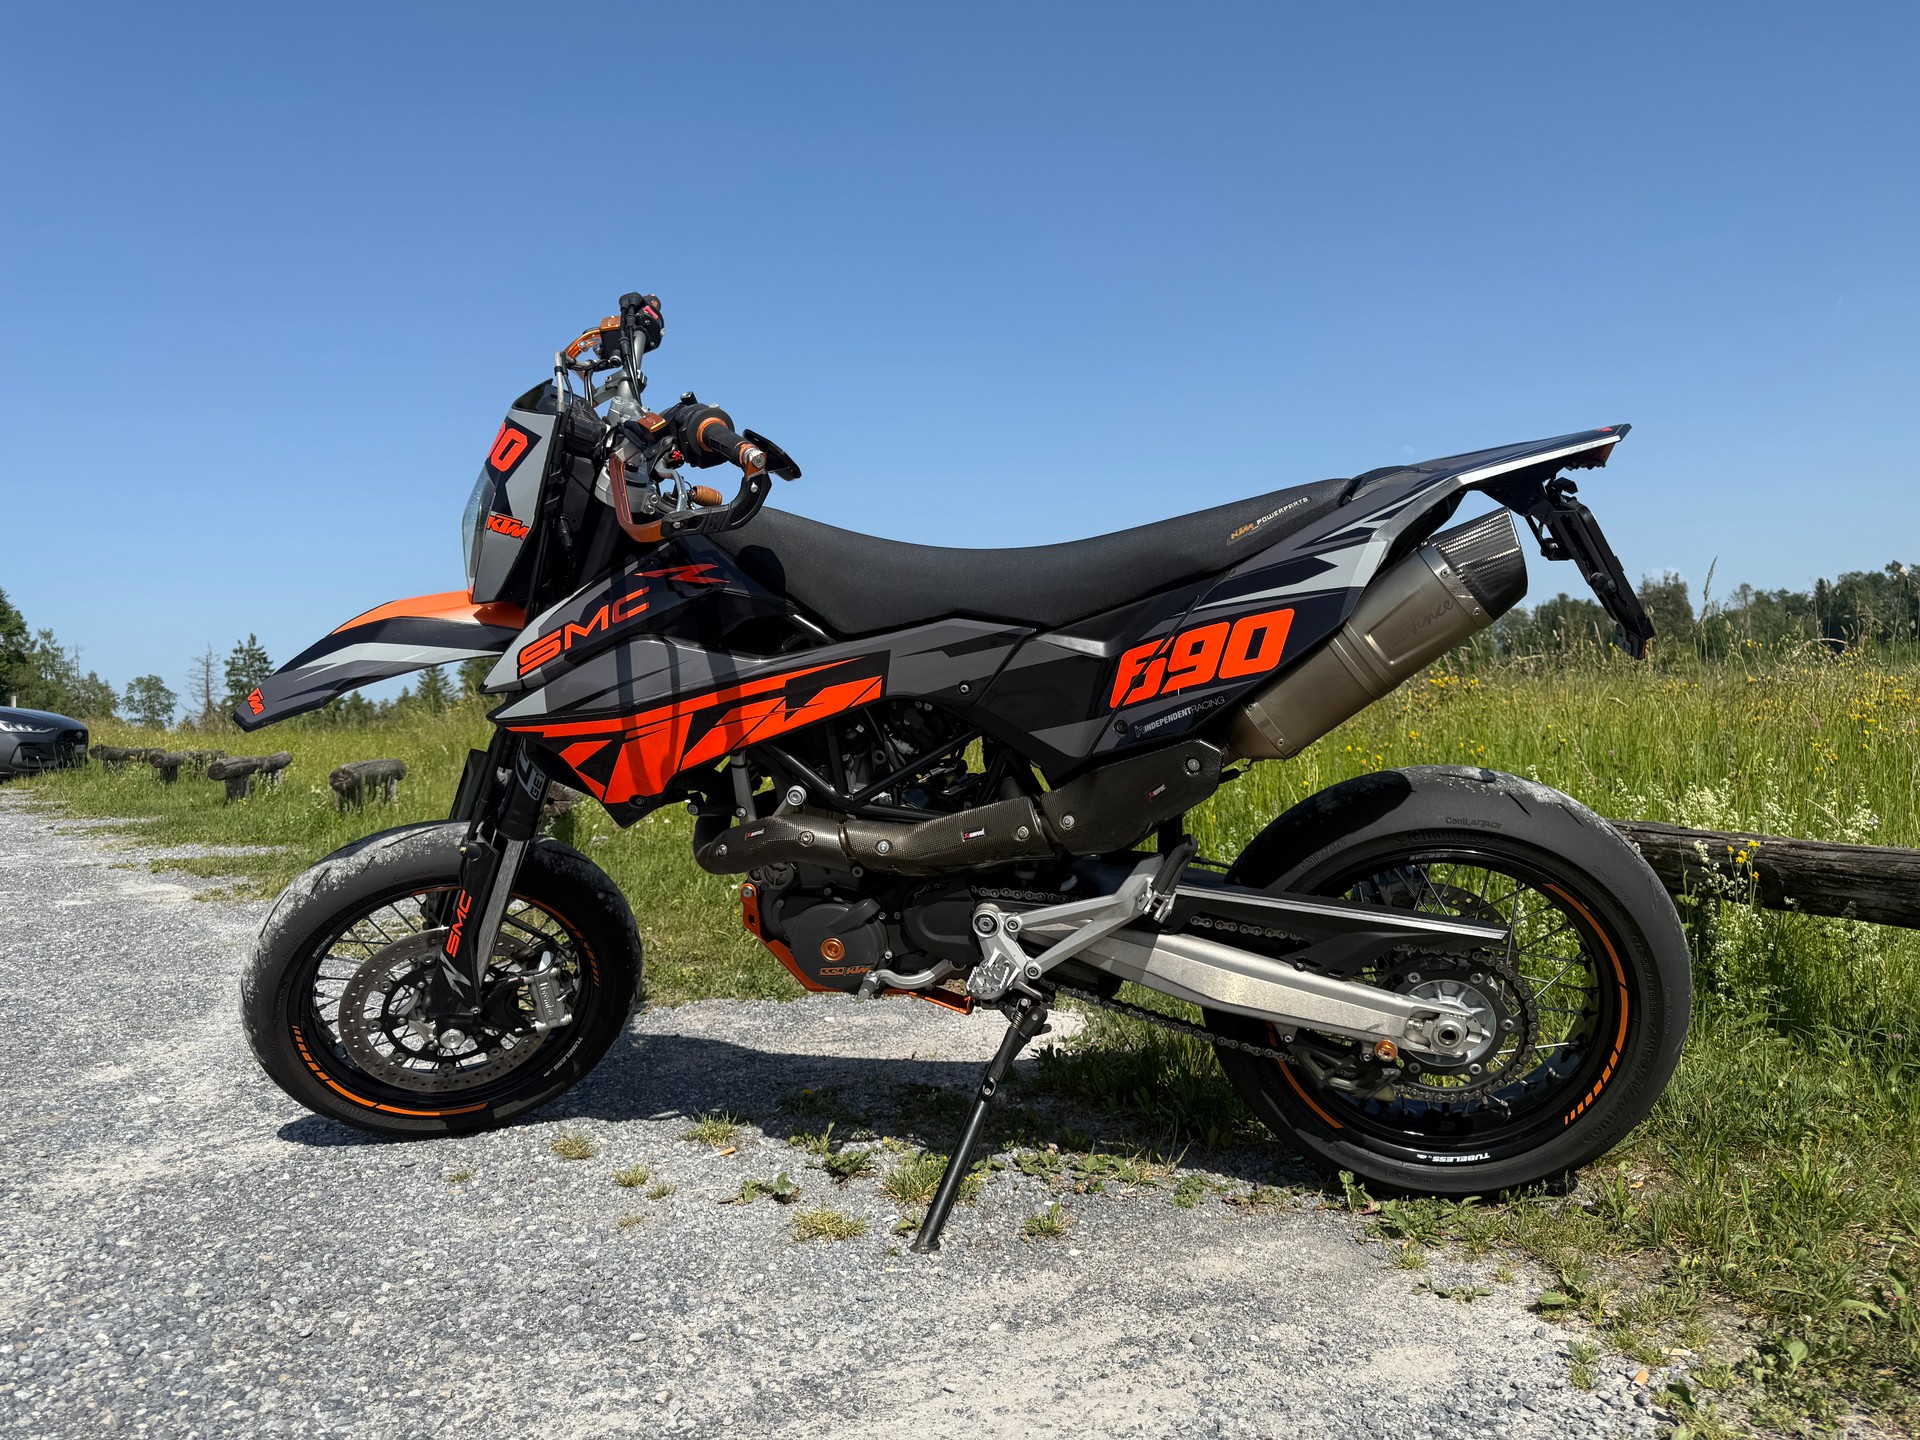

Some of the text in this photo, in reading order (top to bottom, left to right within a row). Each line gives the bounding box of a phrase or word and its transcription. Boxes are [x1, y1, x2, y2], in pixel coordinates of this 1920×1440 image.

[486, 514, 530, 540] KTM
[1231, 497, 1309, 540] KTM POWERPARTS
[519, 586, 650, 676] SMC
[1109, 608, 1295, 709] 690
[446, 889, 473, 958] SMC
[1432, 1152, 1490, 1163] TUBELESS
